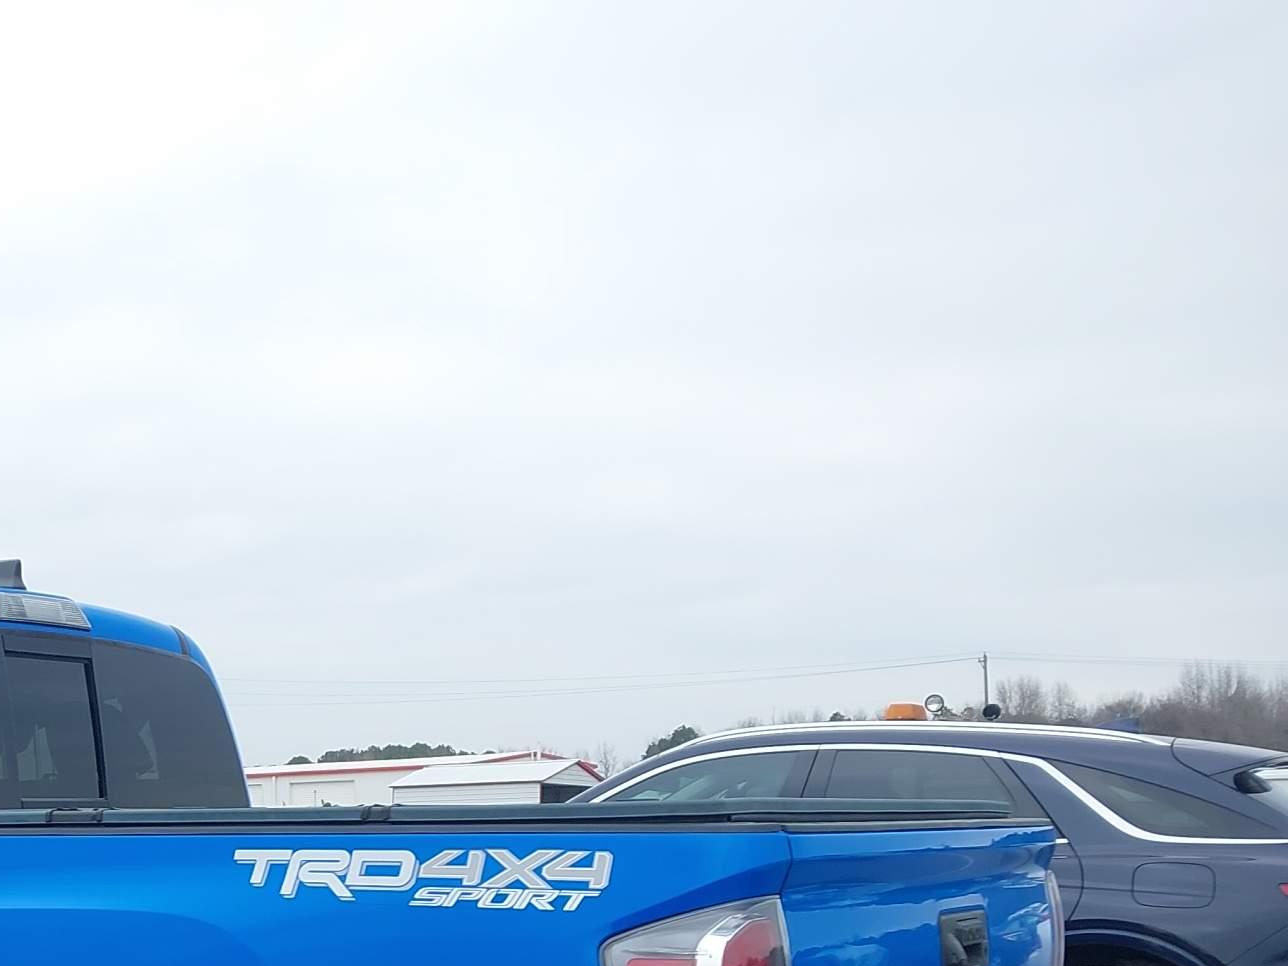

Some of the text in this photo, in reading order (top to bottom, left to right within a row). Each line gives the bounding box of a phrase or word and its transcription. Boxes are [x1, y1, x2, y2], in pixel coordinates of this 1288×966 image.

[233, 849, 614, 901] TRD 4X4
[408, 886, 602, 912] SPORT
